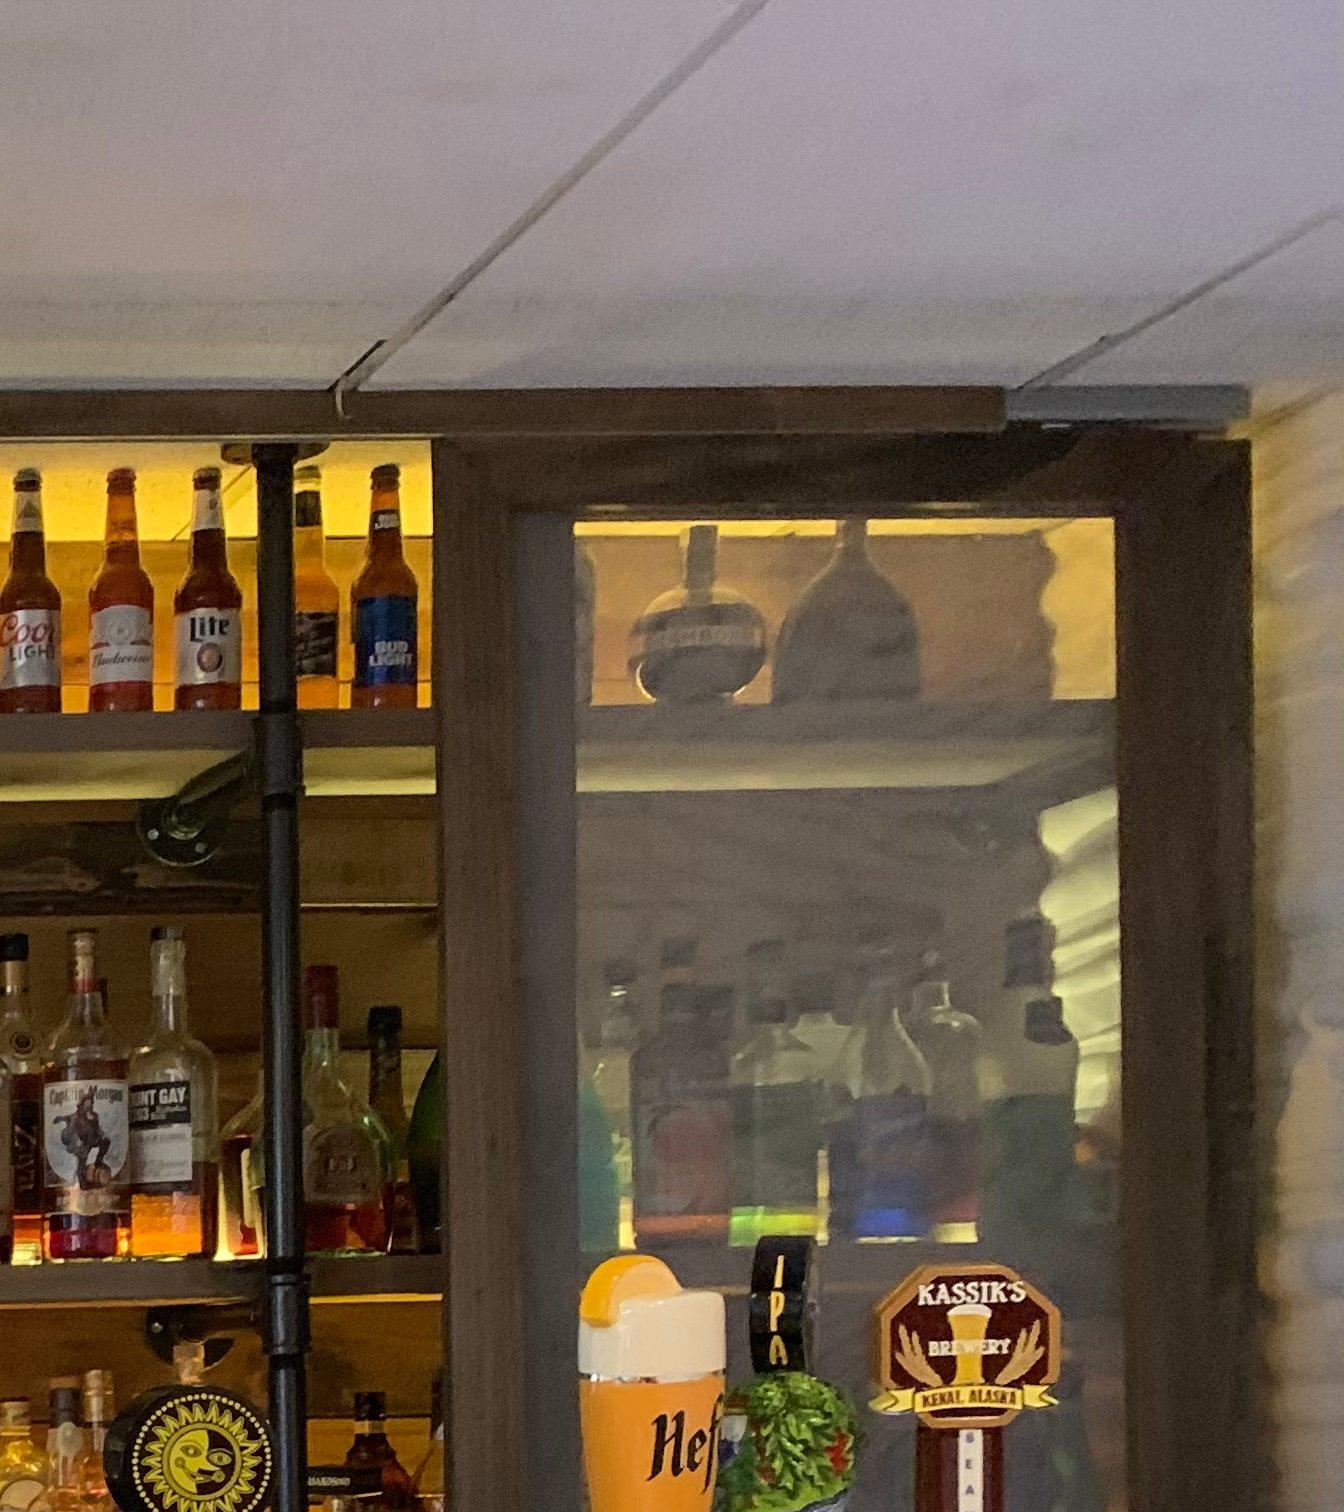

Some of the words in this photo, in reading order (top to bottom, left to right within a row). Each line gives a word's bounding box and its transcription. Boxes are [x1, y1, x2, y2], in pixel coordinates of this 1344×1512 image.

[189, 615, 230, 642] Lite
[374, 640, 408, 653] BUD
[158, 1086, 187, 1105] GAY
[917, 1279, 1028, 1307] KASSIK'S
[768, 1253, 790, 1368] IPA
[928, 1337, 1012, 1357] BREWERY
[967, 1388, 1017, 1405] ALASKA
